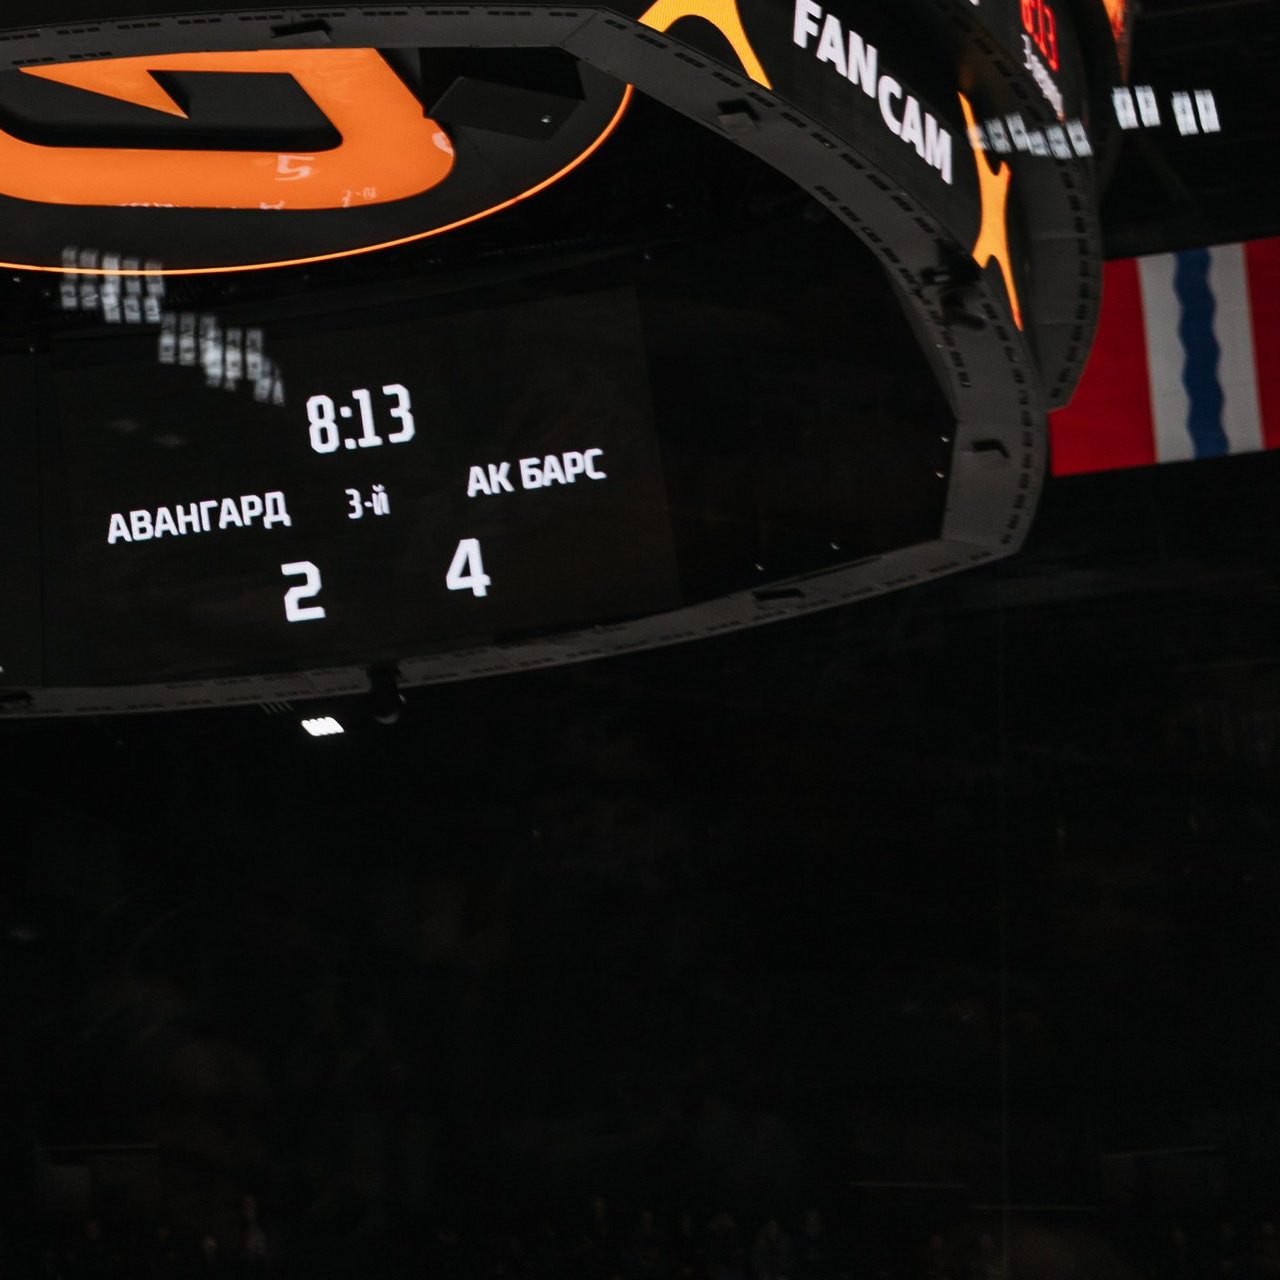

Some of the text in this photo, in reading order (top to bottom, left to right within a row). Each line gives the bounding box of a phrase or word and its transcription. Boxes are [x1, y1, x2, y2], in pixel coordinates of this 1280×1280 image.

[305, 383, 416, 454] 8:13
[466, 447, 607, 498] АК БАРС
[107, 490, 292, 545] АВАНГАРД
[345, 484, 390, 520] 3-й
[280, 560, 326, 622] 2
[445, 537, 491, 597] 4
